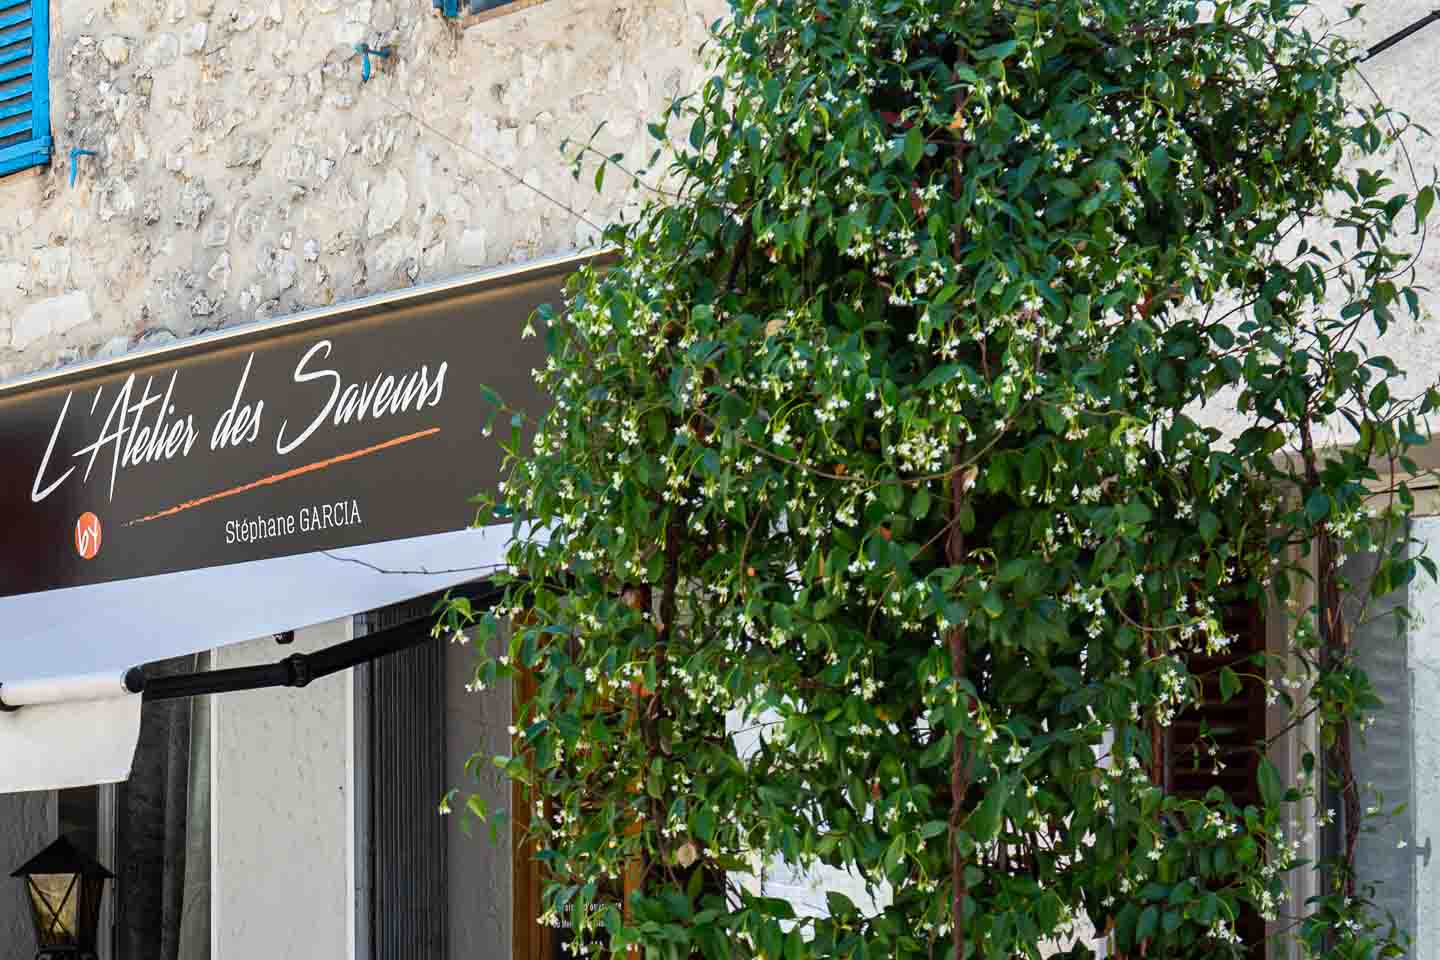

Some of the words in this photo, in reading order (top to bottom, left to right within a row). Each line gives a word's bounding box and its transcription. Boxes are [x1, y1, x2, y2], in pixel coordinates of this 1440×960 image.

[31, 369, 200, 503] L'Atelier
[210, 351, 265, 452] des
[276, 340, 448, 456] Saveurs
[225, 514, 296, 544] Stéphane
[299, 499, 362, 533] GARCIA
